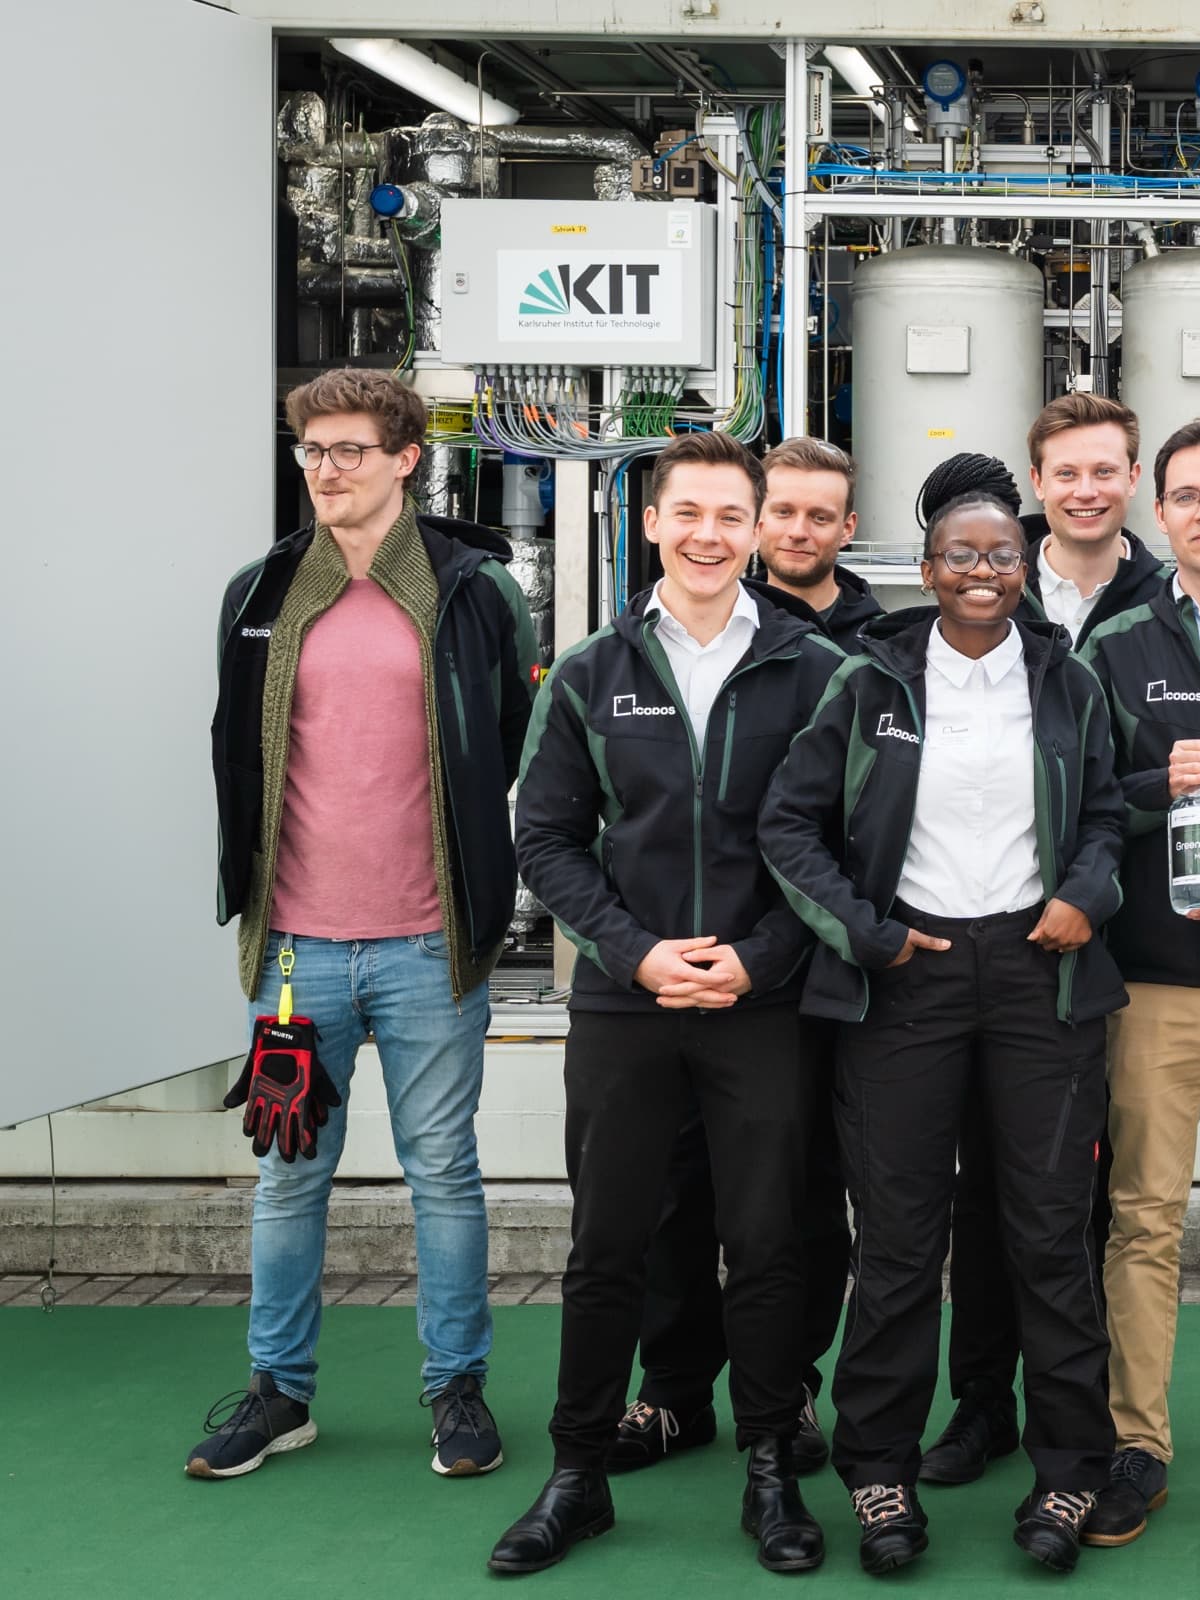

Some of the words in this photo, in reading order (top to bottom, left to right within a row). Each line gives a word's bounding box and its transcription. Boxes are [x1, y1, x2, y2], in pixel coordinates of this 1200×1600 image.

[558, 264, 660, 315] KIT
[518, 319, 561, 328] Karlsruher
[563, 319, 593, 328] Institut
[595, 319, 609, 328] für
[610, 319, 661, 330] Technologie
[1175, 841, 1200, 851] Green
